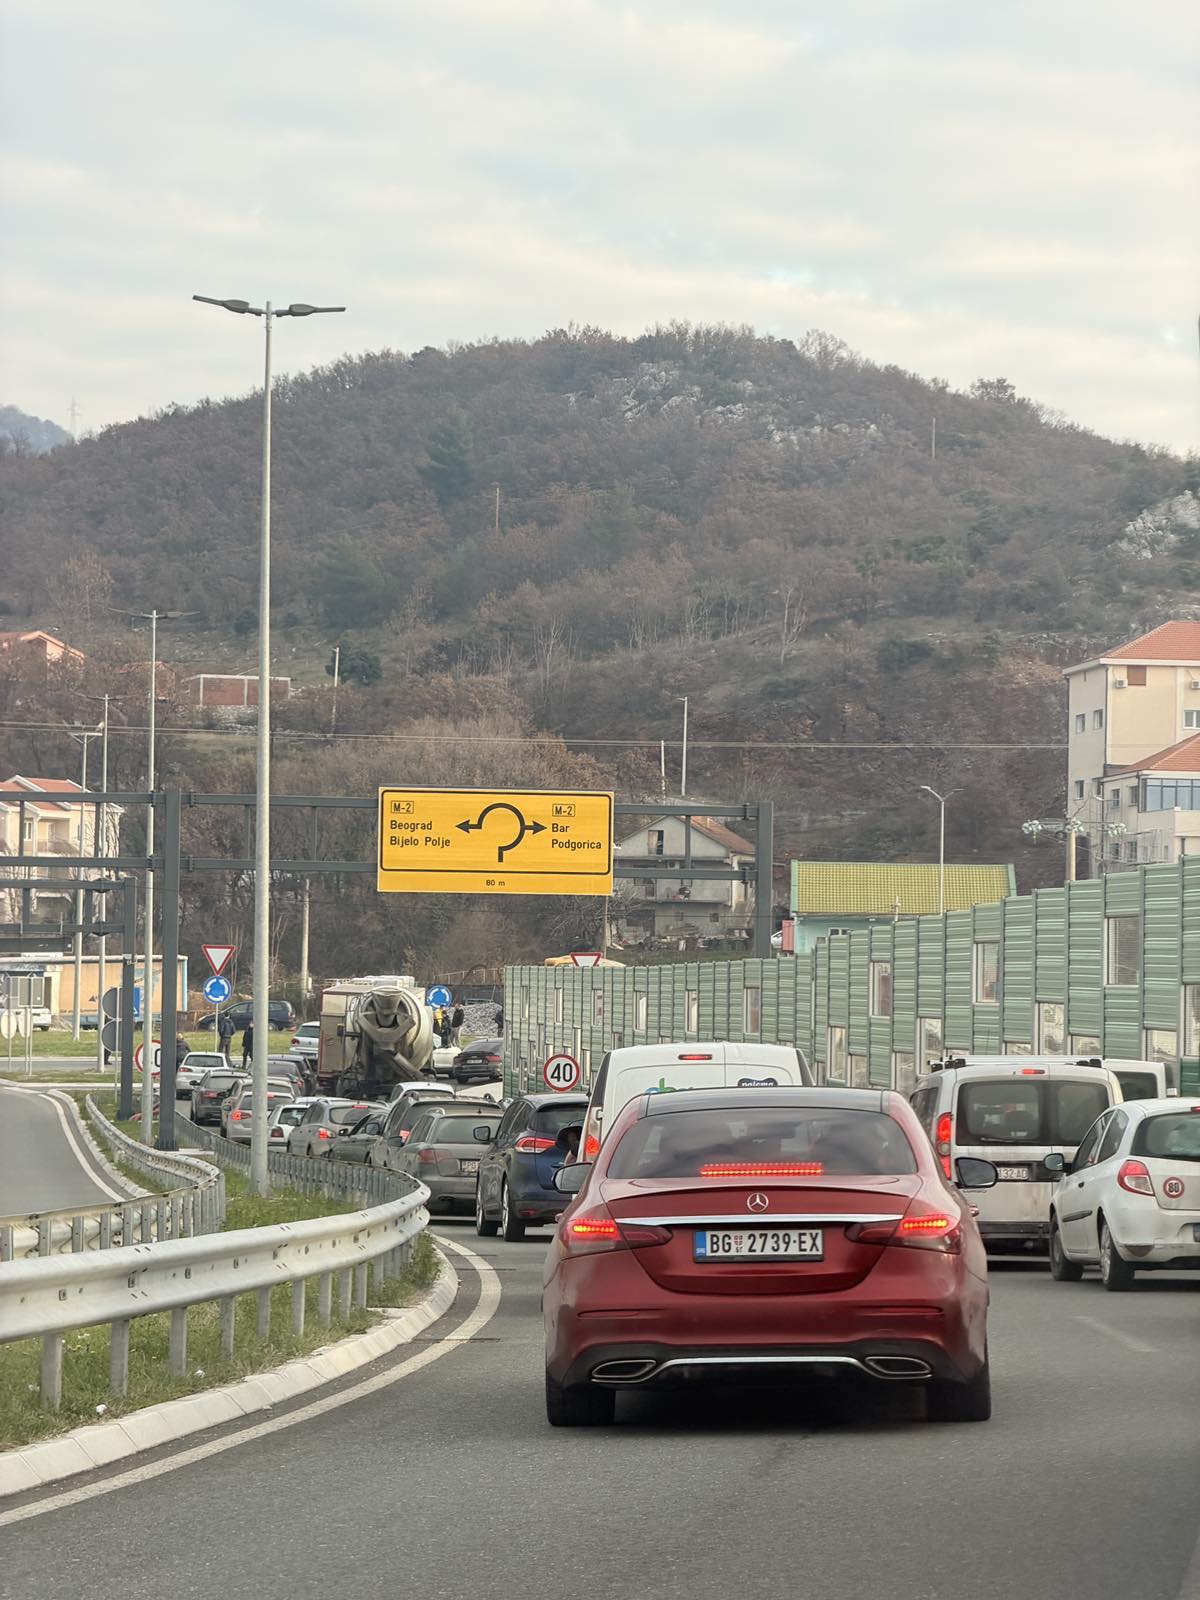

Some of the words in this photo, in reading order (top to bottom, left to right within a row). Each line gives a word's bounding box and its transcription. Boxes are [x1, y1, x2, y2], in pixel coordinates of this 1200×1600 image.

[393, 802, 411, 813] M-2
[555, 805, 573, 816] M-2
[390, 820, 432, 832] Beograd
[552, 823, 570, 833] Bar
[390, 836, 419, 848] Bijelo
[425, 836, 451, 848] Polje
[552, 839, 602, 851] Podgorica
[550, 1063, 573, 1082] 40
[1168, 1182, 1180, 1193] 80
[710, 1233, 731, 1254] BG
